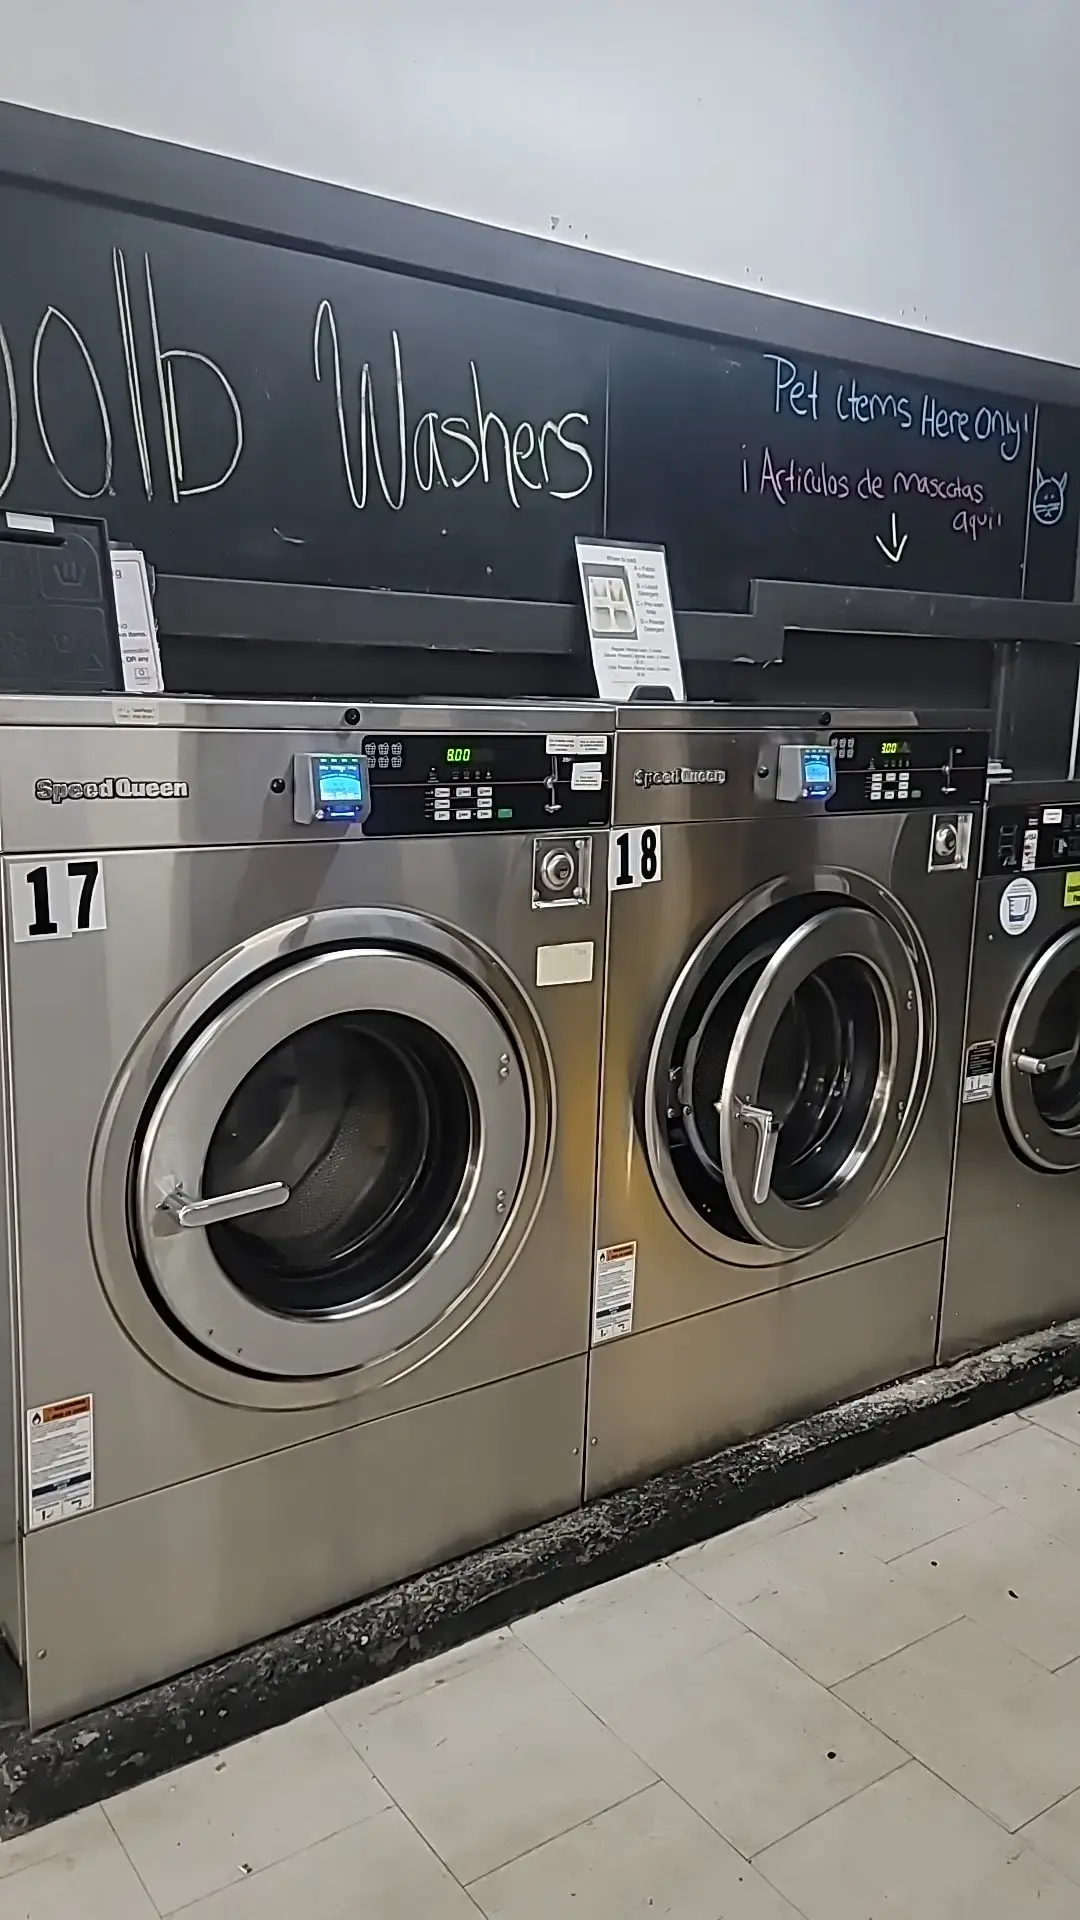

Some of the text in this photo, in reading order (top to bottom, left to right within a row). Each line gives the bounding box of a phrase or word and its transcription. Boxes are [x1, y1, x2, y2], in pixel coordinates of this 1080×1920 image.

[313, 299, 593, 509] Washers
[762, 353, 818, 421] Pet
[921, 394, 971, 442] Here
[857, 468, 886, 500] de
[35, 777, 189, 804] Speed Queen
[635, 768, 681, 789] Speed
[616, 828, 658, 886] 18
[26, 860, 99, 936] 17
